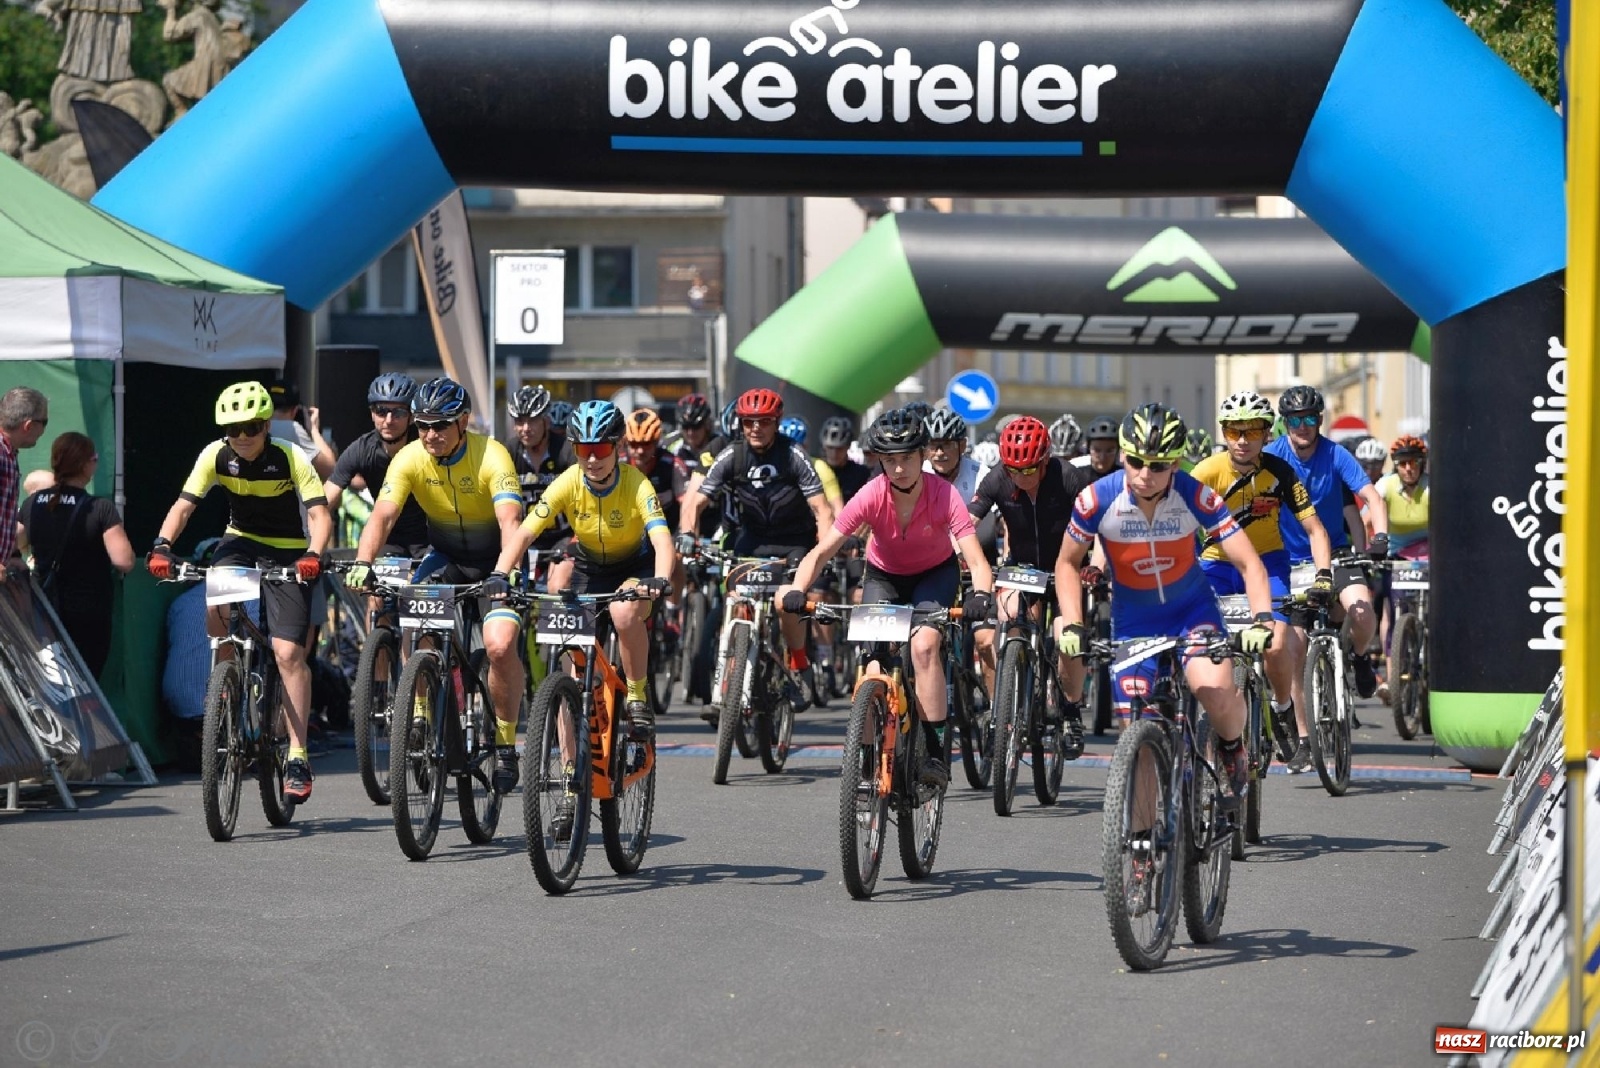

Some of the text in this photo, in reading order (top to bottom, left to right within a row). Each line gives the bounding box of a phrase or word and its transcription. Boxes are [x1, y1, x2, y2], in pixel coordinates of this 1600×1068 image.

[609, 35, 1117, 124] bike atelier
[511, 263, 548, 272] SEKTOR
[521, 278, 541, 286] PRO
[521, 308, 538, 333] 0
[990, 313, 1359, 345] MERIDA
[408, 600, 444, 614] 2032
[547, 613, 583, 630] 2031
